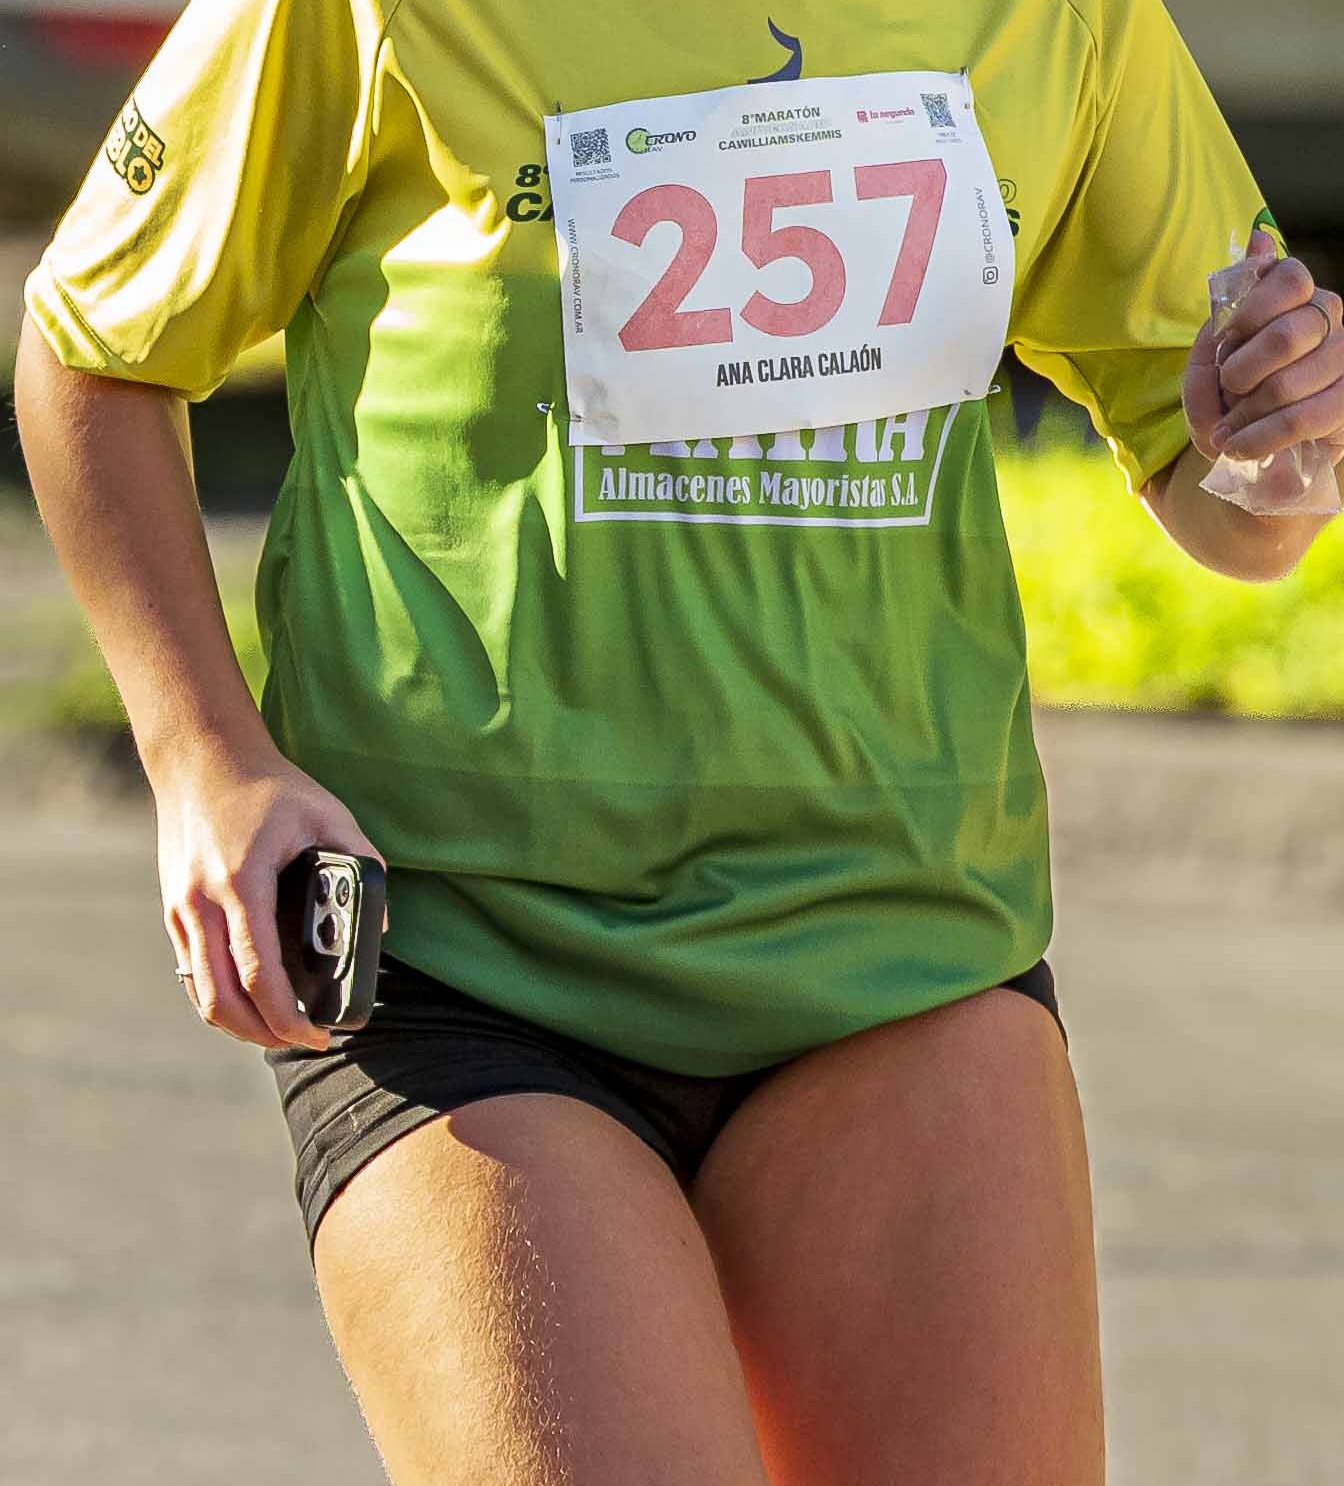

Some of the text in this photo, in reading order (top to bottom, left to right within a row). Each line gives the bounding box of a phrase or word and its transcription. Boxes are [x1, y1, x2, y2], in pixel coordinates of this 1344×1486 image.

[718, 129, 842, 151] CAWILLIAMSKEMMIS
[610, 157, 948, 353] 257
[716, 343, 883, 387] ANA CLARA CALAÓN
[598, 467, 751, 505] Almacenes
[758, 471, 887, 510] Mayoristas
